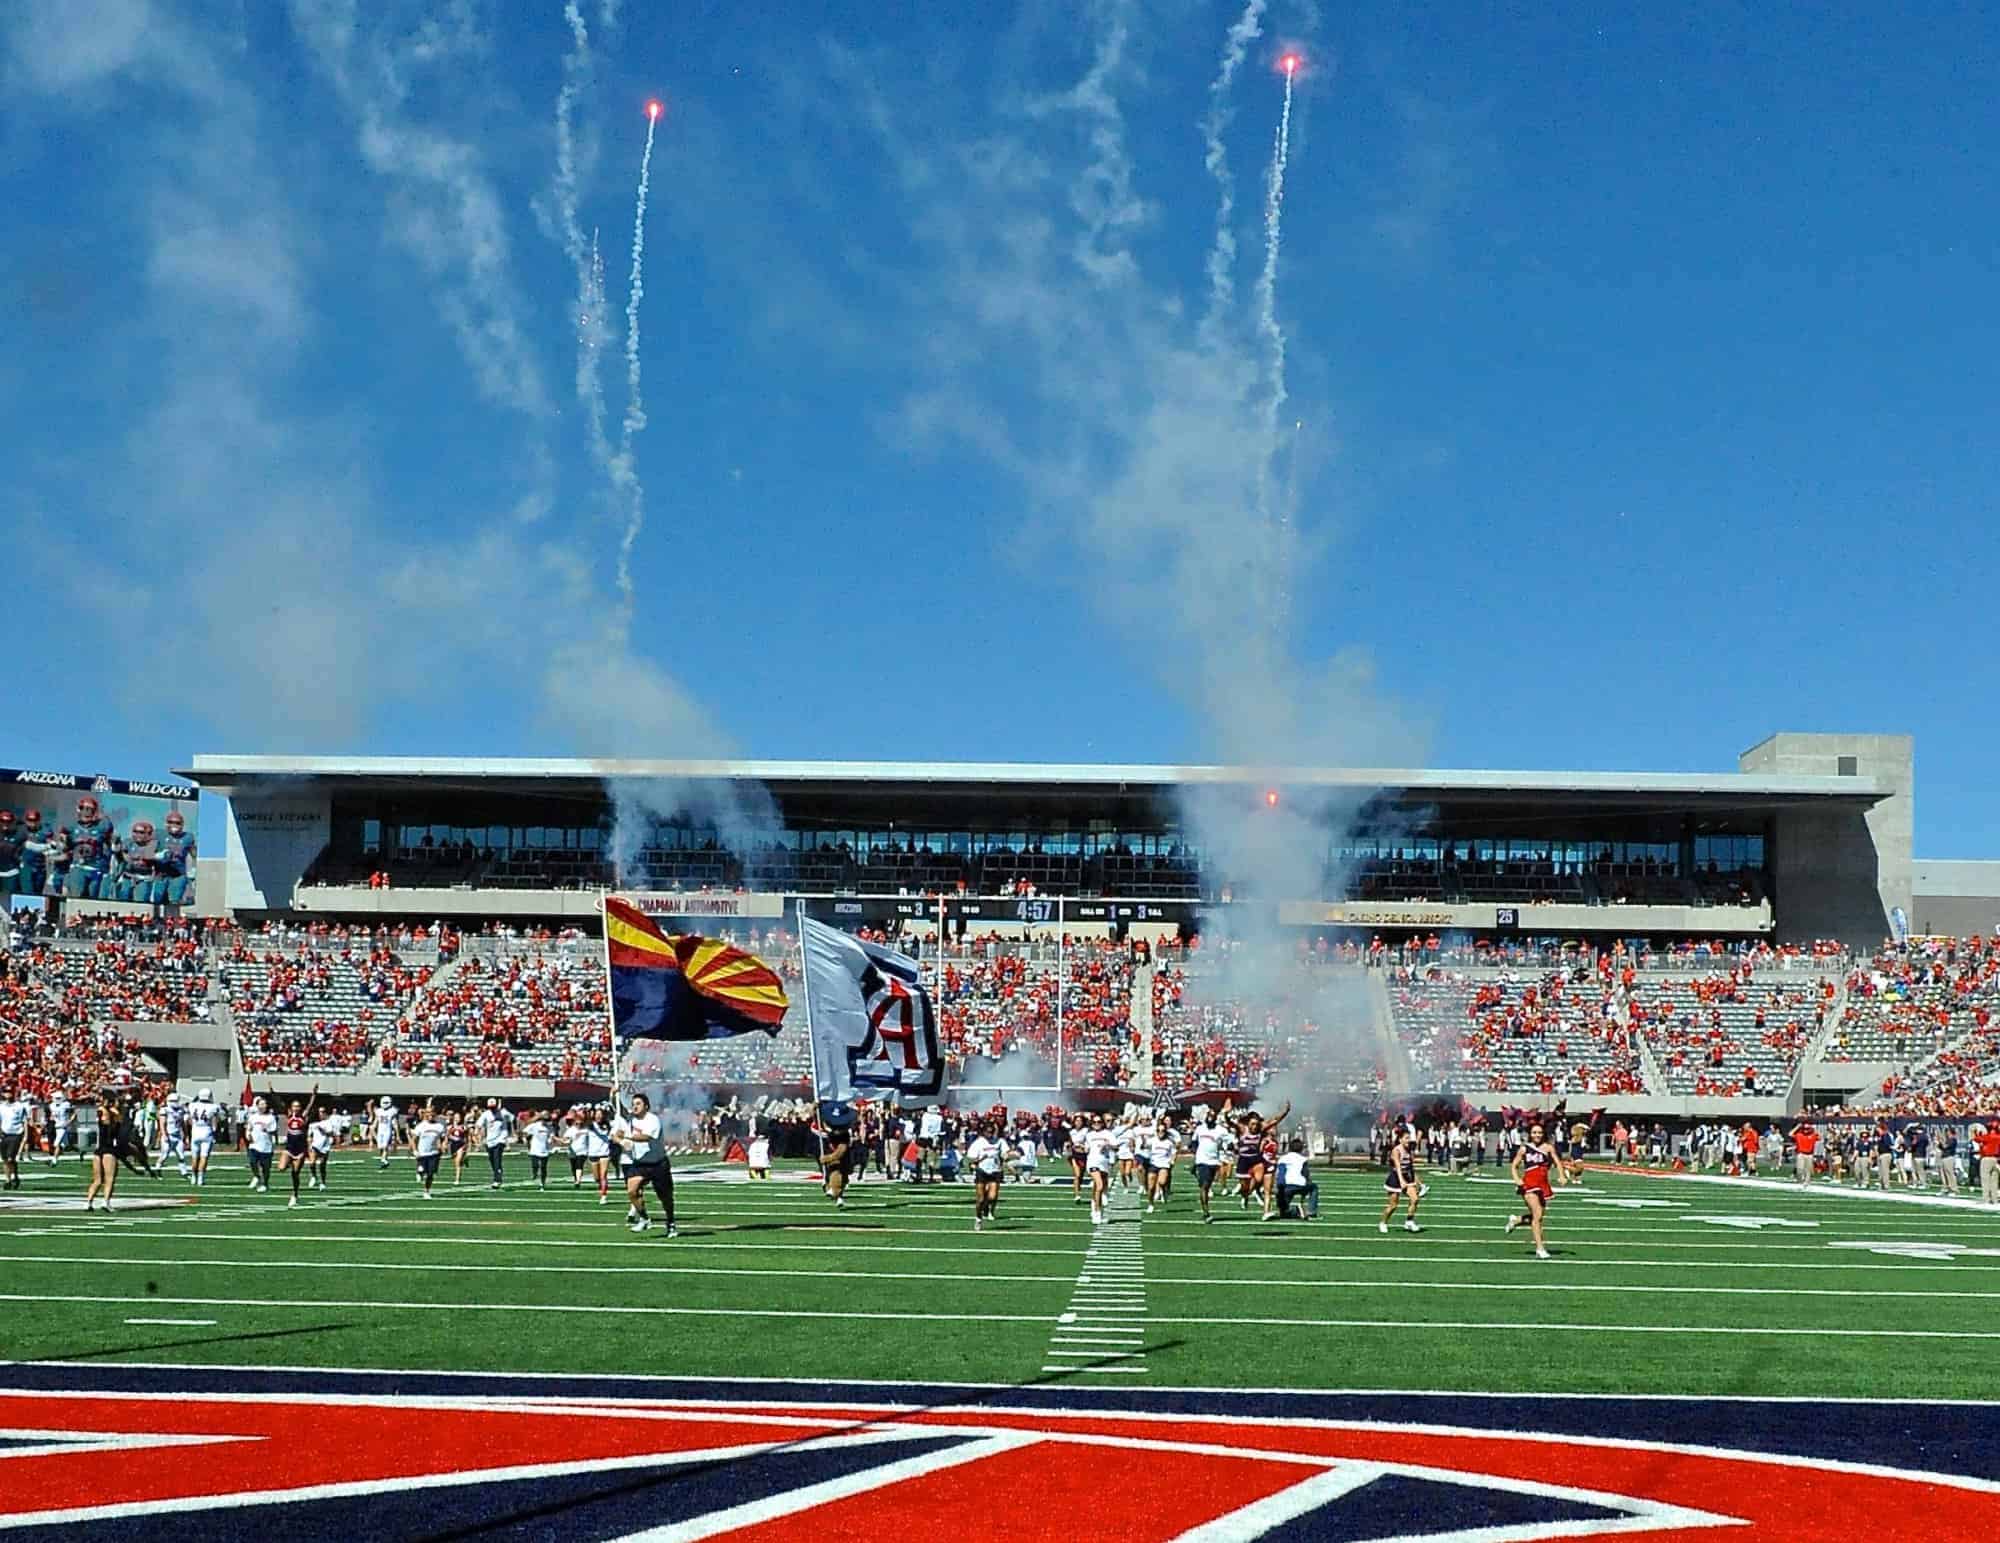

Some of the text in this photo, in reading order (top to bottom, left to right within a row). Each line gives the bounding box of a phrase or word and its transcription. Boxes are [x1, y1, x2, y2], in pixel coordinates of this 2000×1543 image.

[16, 771, 76, 787] ARIZONA
[128, 781, 192, 798] WILDCATS
[639, 899, 681, 913] CHAPMAN
[1016, 901, 1053, 920] 4:57
[1498, 910, 1513, 924] 25
